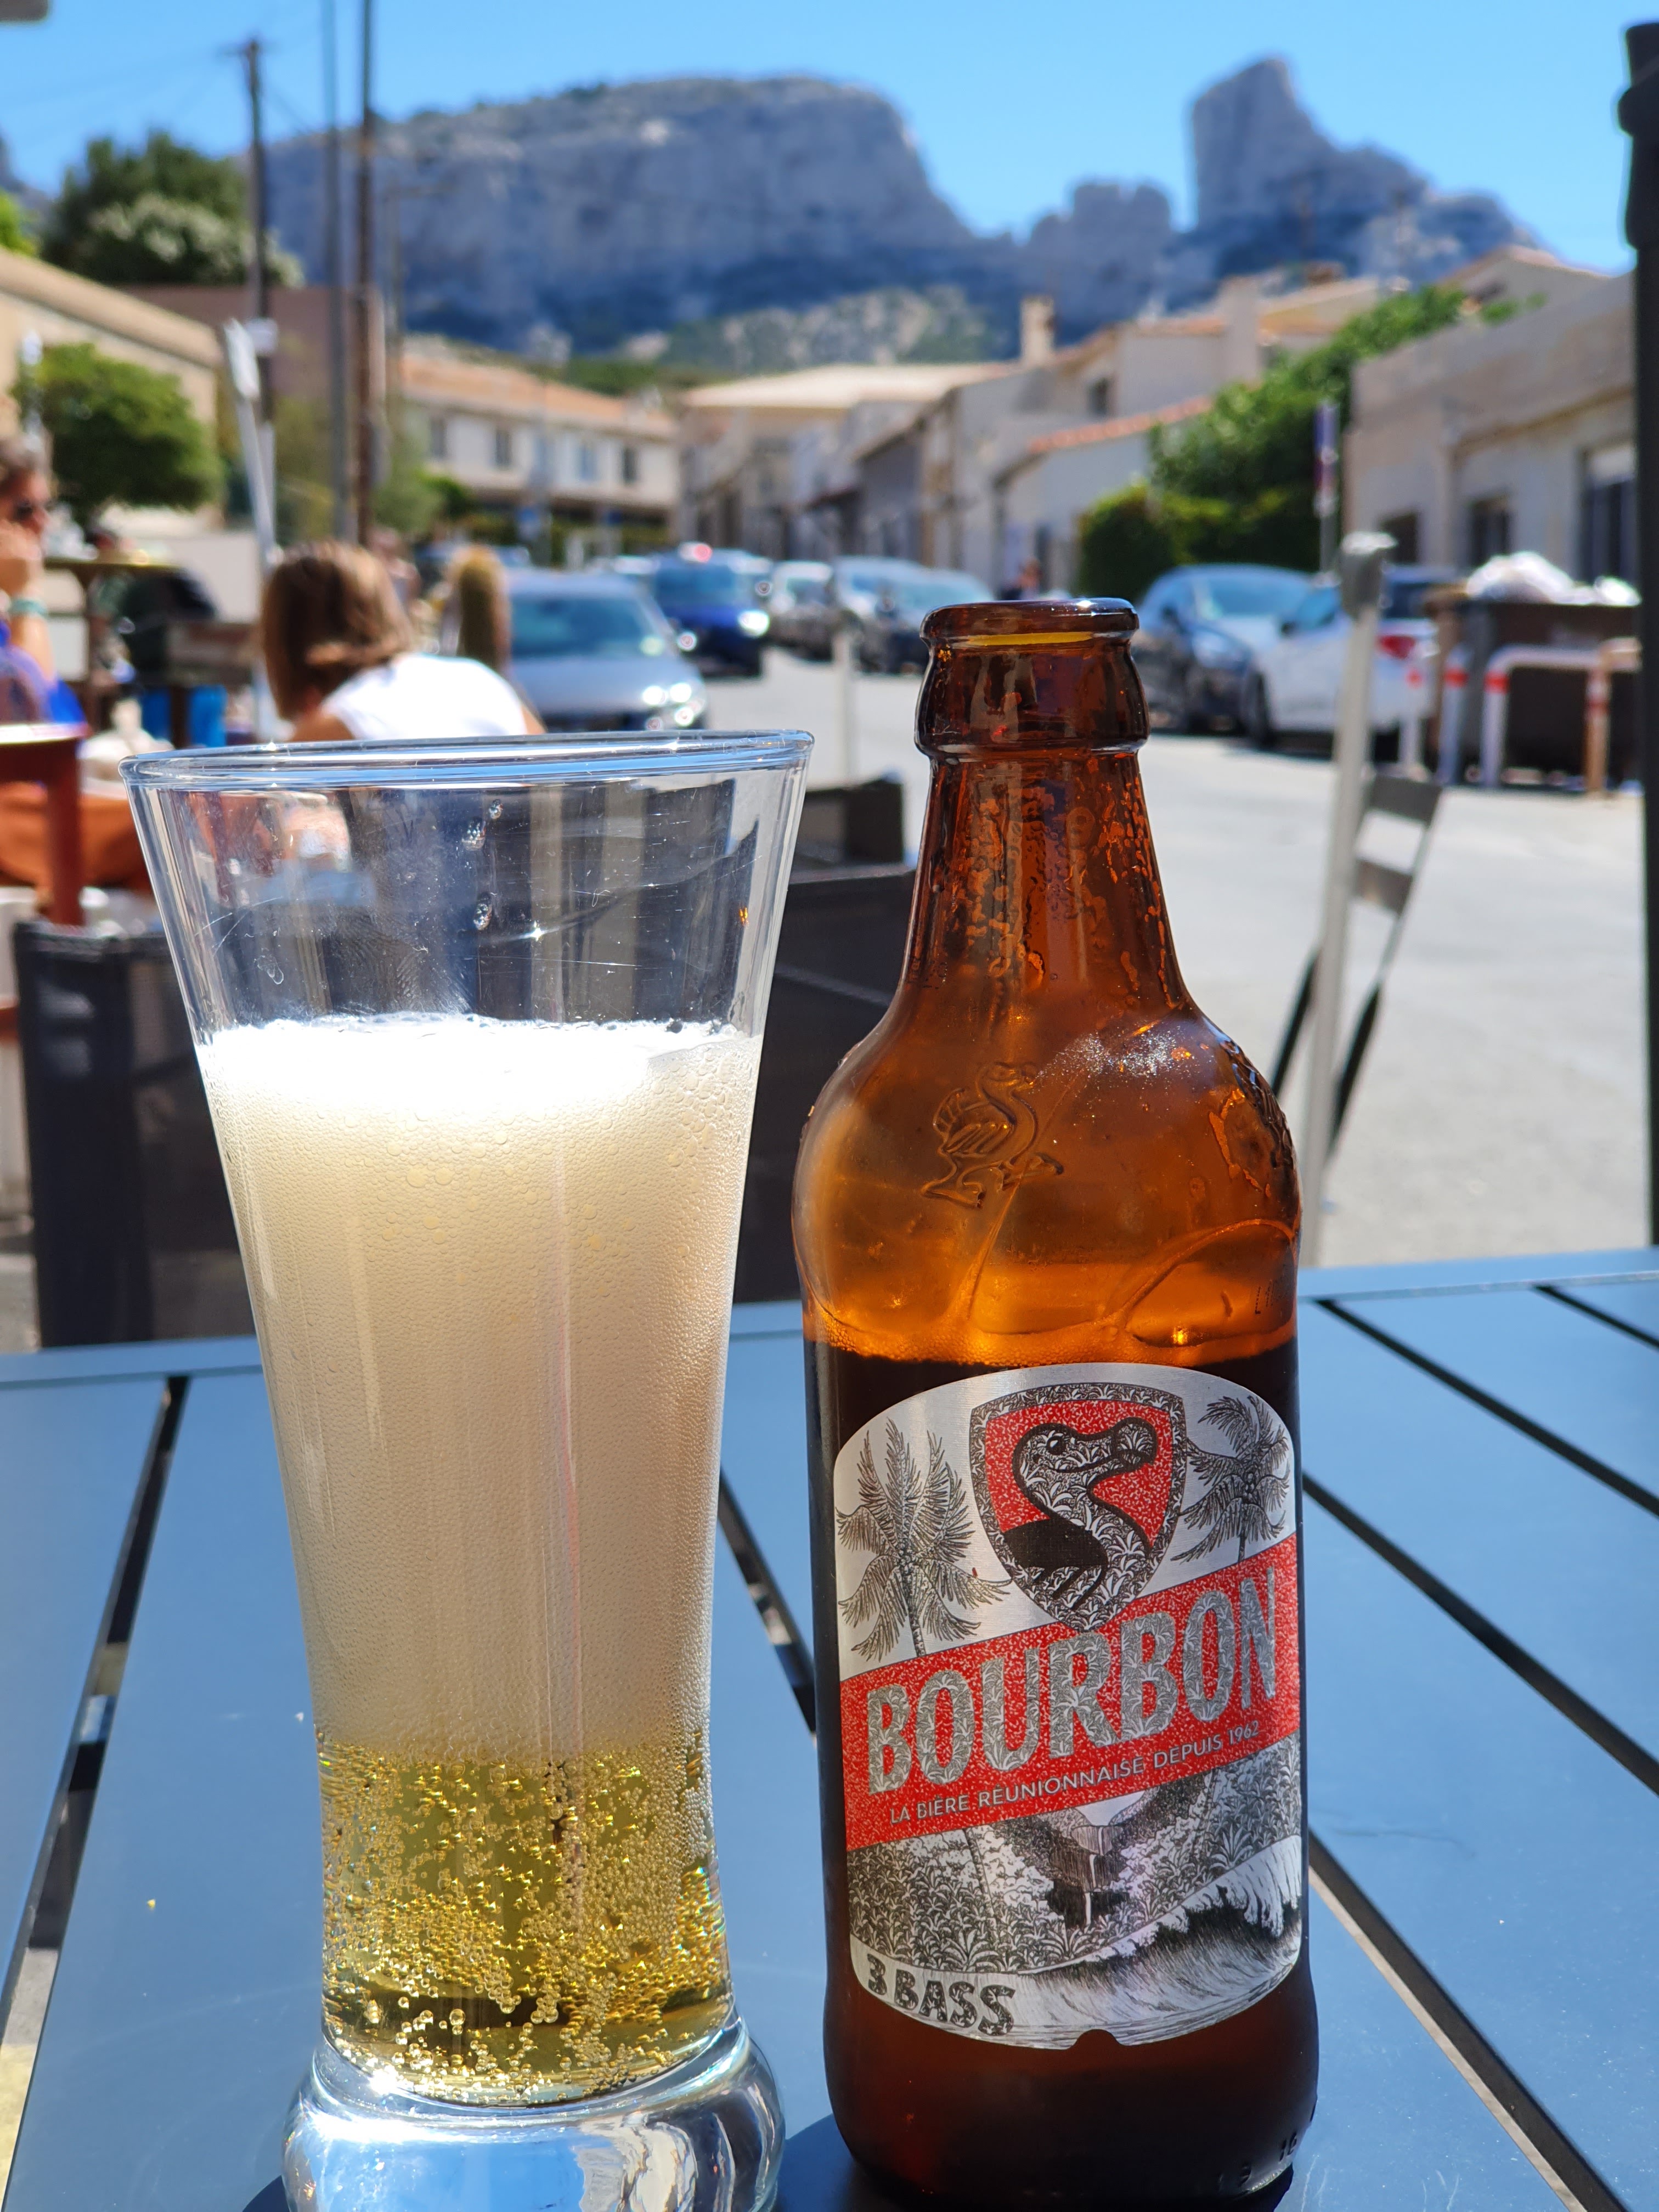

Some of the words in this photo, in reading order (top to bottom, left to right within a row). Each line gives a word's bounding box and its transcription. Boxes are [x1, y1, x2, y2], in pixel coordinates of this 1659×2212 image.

[867, 1567, 1276, 1796] BOURBON
[890, 1805, 911, 1824] LA
[917, 1795, 970, 1819] BIÈRE
[978, 1756, 1146, 1809] RÉUNIONNAISE
[1153, 1734, 1222, 1769] DEPUIS
[1228, 1720, 1260, 1745] 1962
[867, 1953, 888, 1996] 3
[894, 1968, 1015, 2036] BASS
